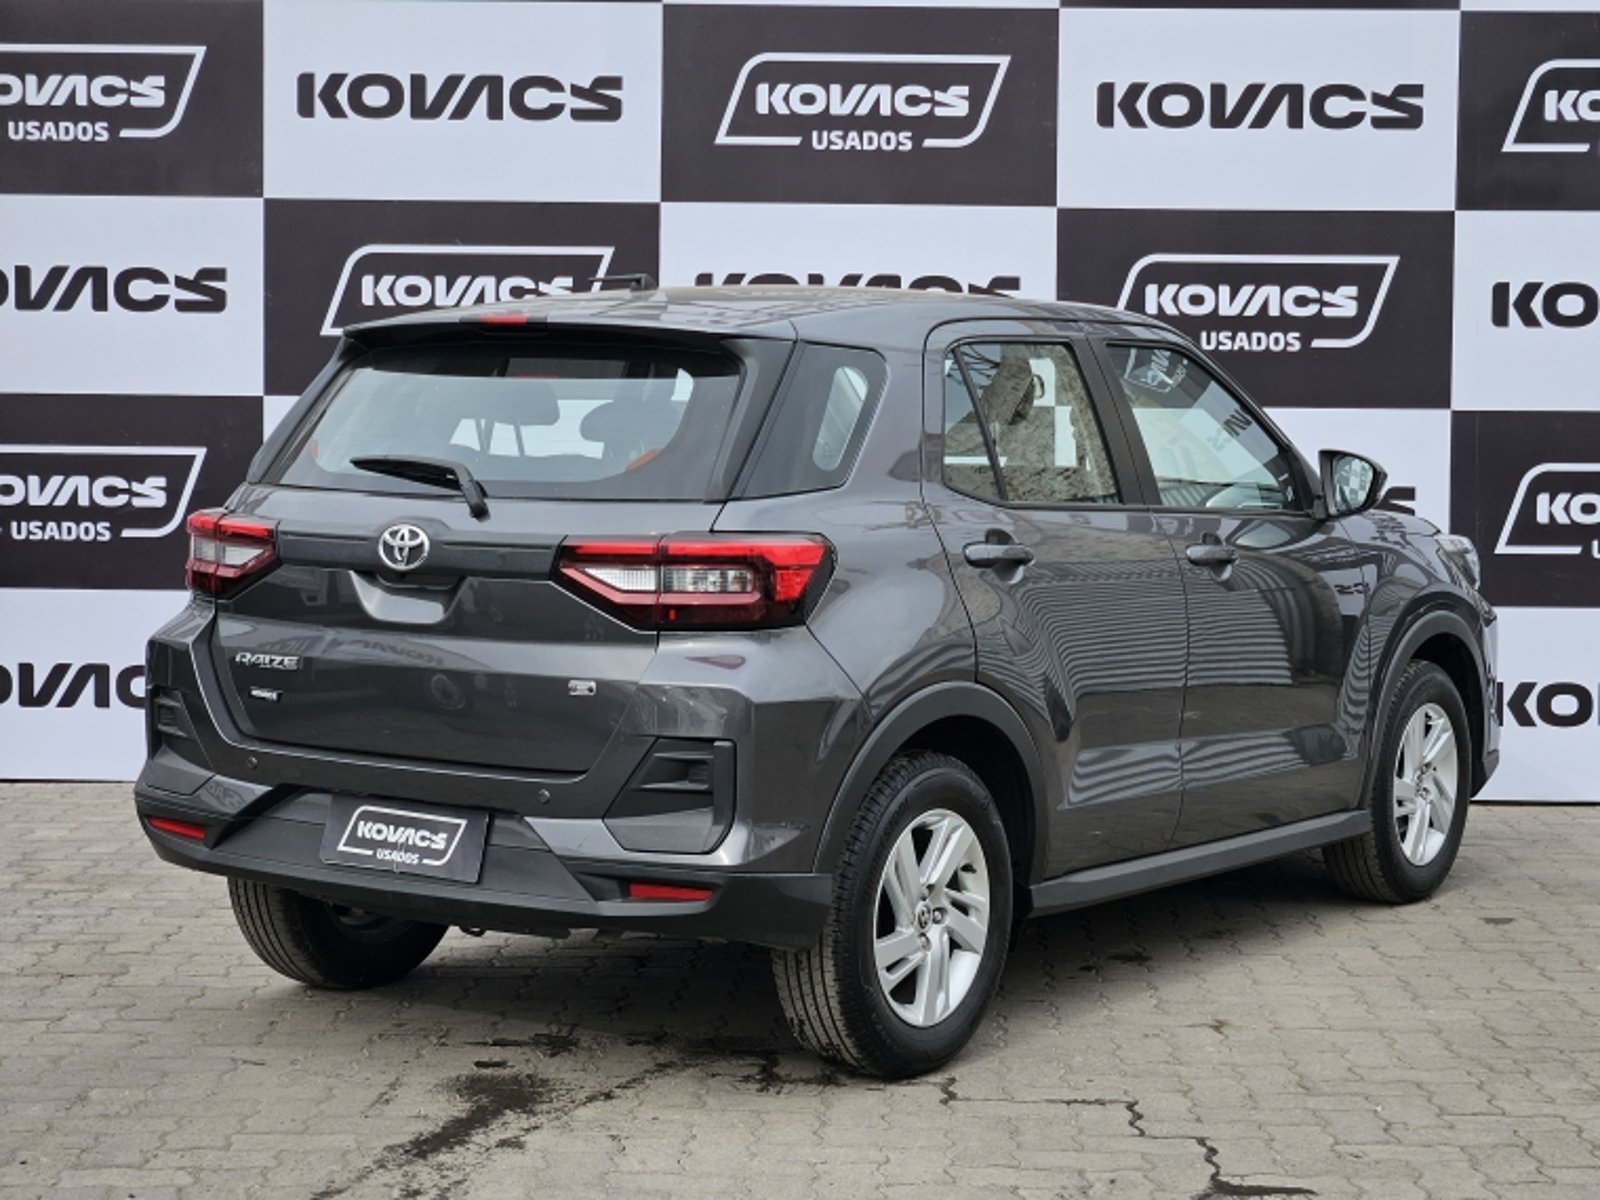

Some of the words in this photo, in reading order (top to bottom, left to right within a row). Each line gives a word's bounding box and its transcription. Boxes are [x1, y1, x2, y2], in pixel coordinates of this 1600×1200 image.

[297, 72, 623, 122] KOVACS
[756, 83, 969, 117] KOVACS
[1097, 82, 1424, 129] KOVACS
[8, 121, 109, 142] USADOS
[812, 131, 912, 151] USADOS
[1144, 284, 1358, 317] KOVACS
[1200, 331, 1301, 352] USADOS
[11, 521, 111, 542] USADOS
[357, 820, 448, 850] KOVACS
[376, 848, 420, 865] USADOS
